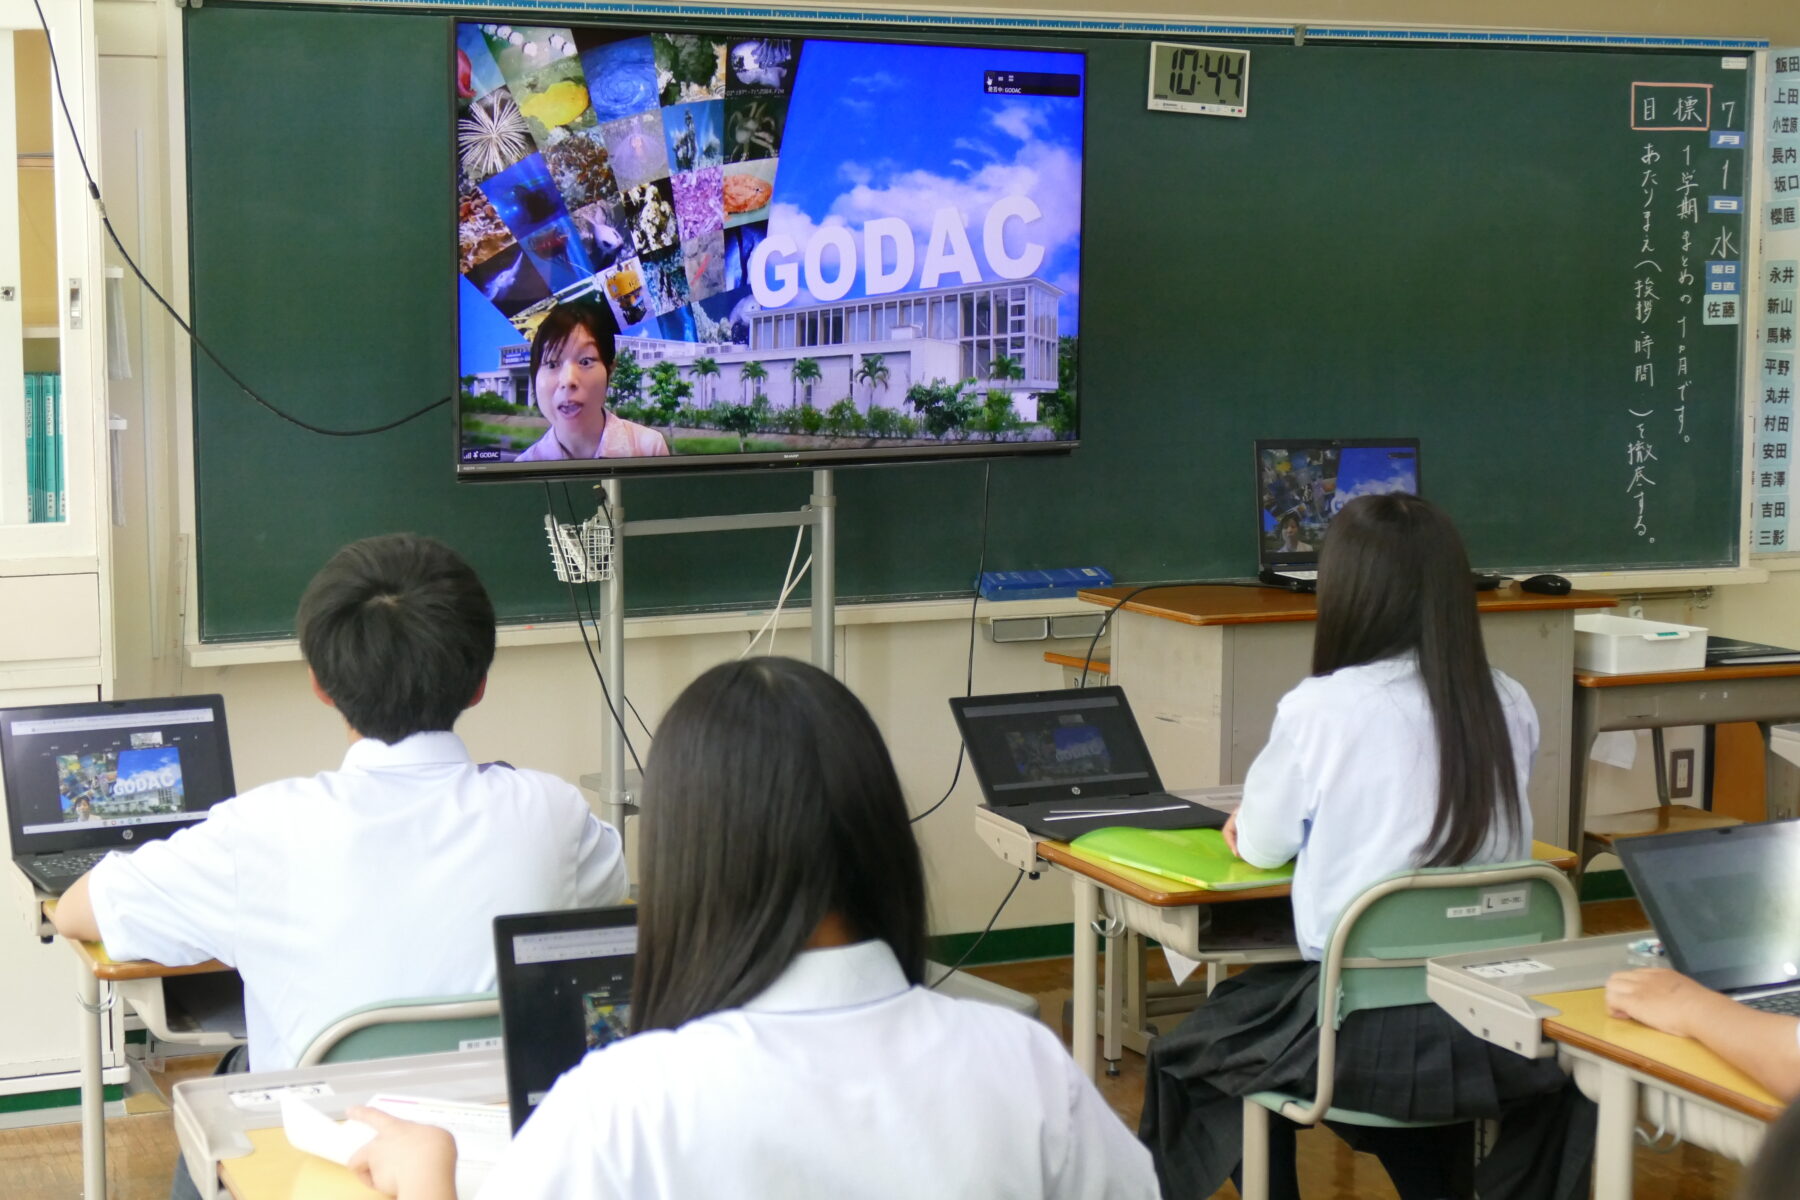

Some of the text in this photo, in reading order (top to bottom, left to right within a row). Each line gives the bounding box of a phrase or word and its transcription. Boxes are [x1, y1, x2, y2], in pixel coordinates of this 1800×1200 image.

[1169, 48, 1245, 99] 10:44
[1773, 87, 1799, 105] 上田
[1772, 116, 1798, 133] 小笠原
[1771, 147, 1797, 164] 長内
[1774, 175, 1799, 192] 坂口
[750, 196, 1046, 308] GODAC
[1769, 266, 1794, 283] 永井
[1707, 301, 1736, 319] 佐藤
[1767, 297, 1793, 314] 新山
[1764, 358, 1790, 376] 平野
[1764, 386, 1790, 404] 丸井
[1764, 415, 1790, 432] 村田
[1762, 443, 1787, 460] 安田
[1760, 471, 1786, 488] 吉澤
[1761, 501, 1786, 518] 吉田
[1758, 529, 1785, 546] 三影
[112, 772, 176, 796] GODAC
